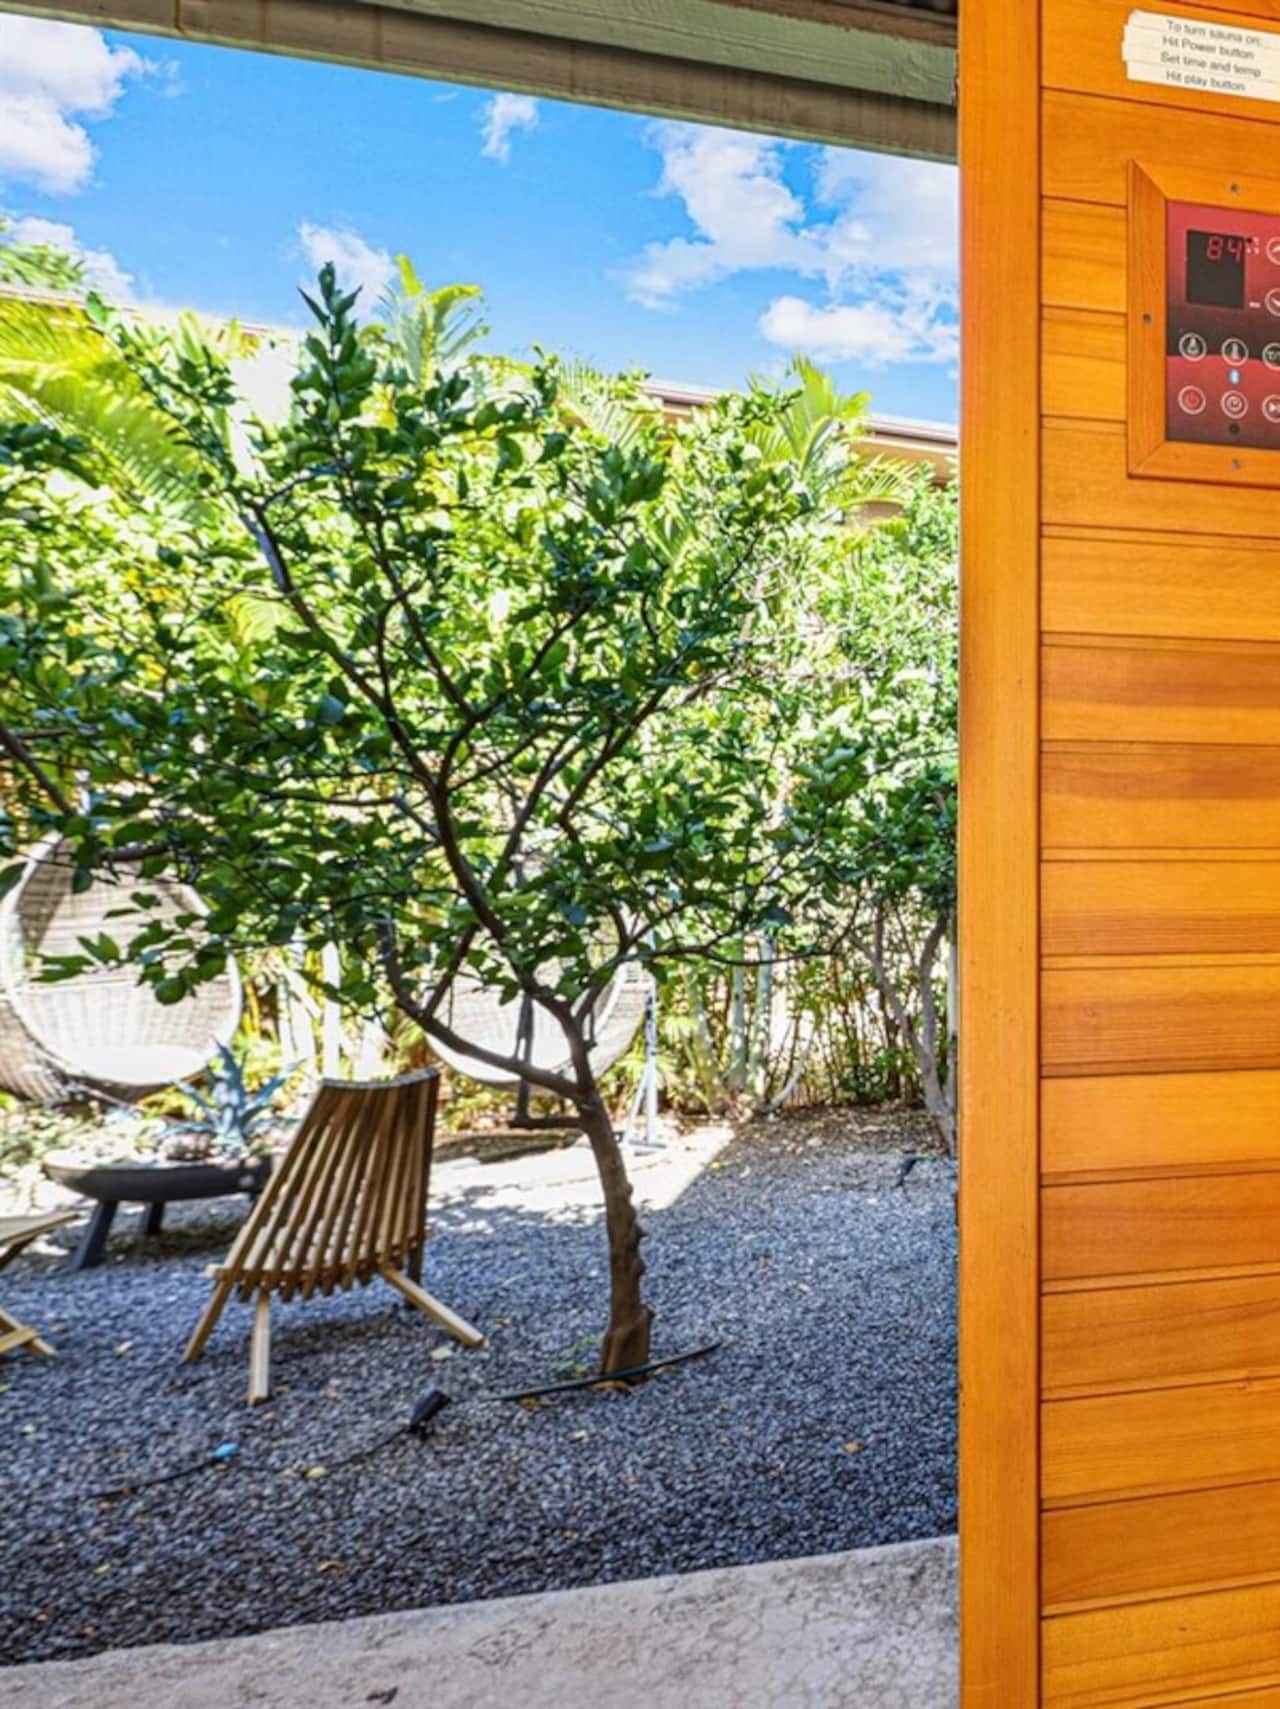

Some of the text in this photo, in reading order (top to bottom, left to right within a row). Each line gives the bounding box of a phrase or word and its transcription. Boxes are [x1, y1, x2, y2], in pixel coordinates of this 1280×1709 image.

[1166, 19, 1181, 32] To
[1184, 23, 1206, 37] turn
[1209, 29, 1243, 43] sauna
[1162, 36, 1255, 60] Hit Power button
[1160, 51, 1261, 77] Set time and temp
[1166, 70, 1246, 91] Hit play button
[1207, 236, 1242, 262] 84
